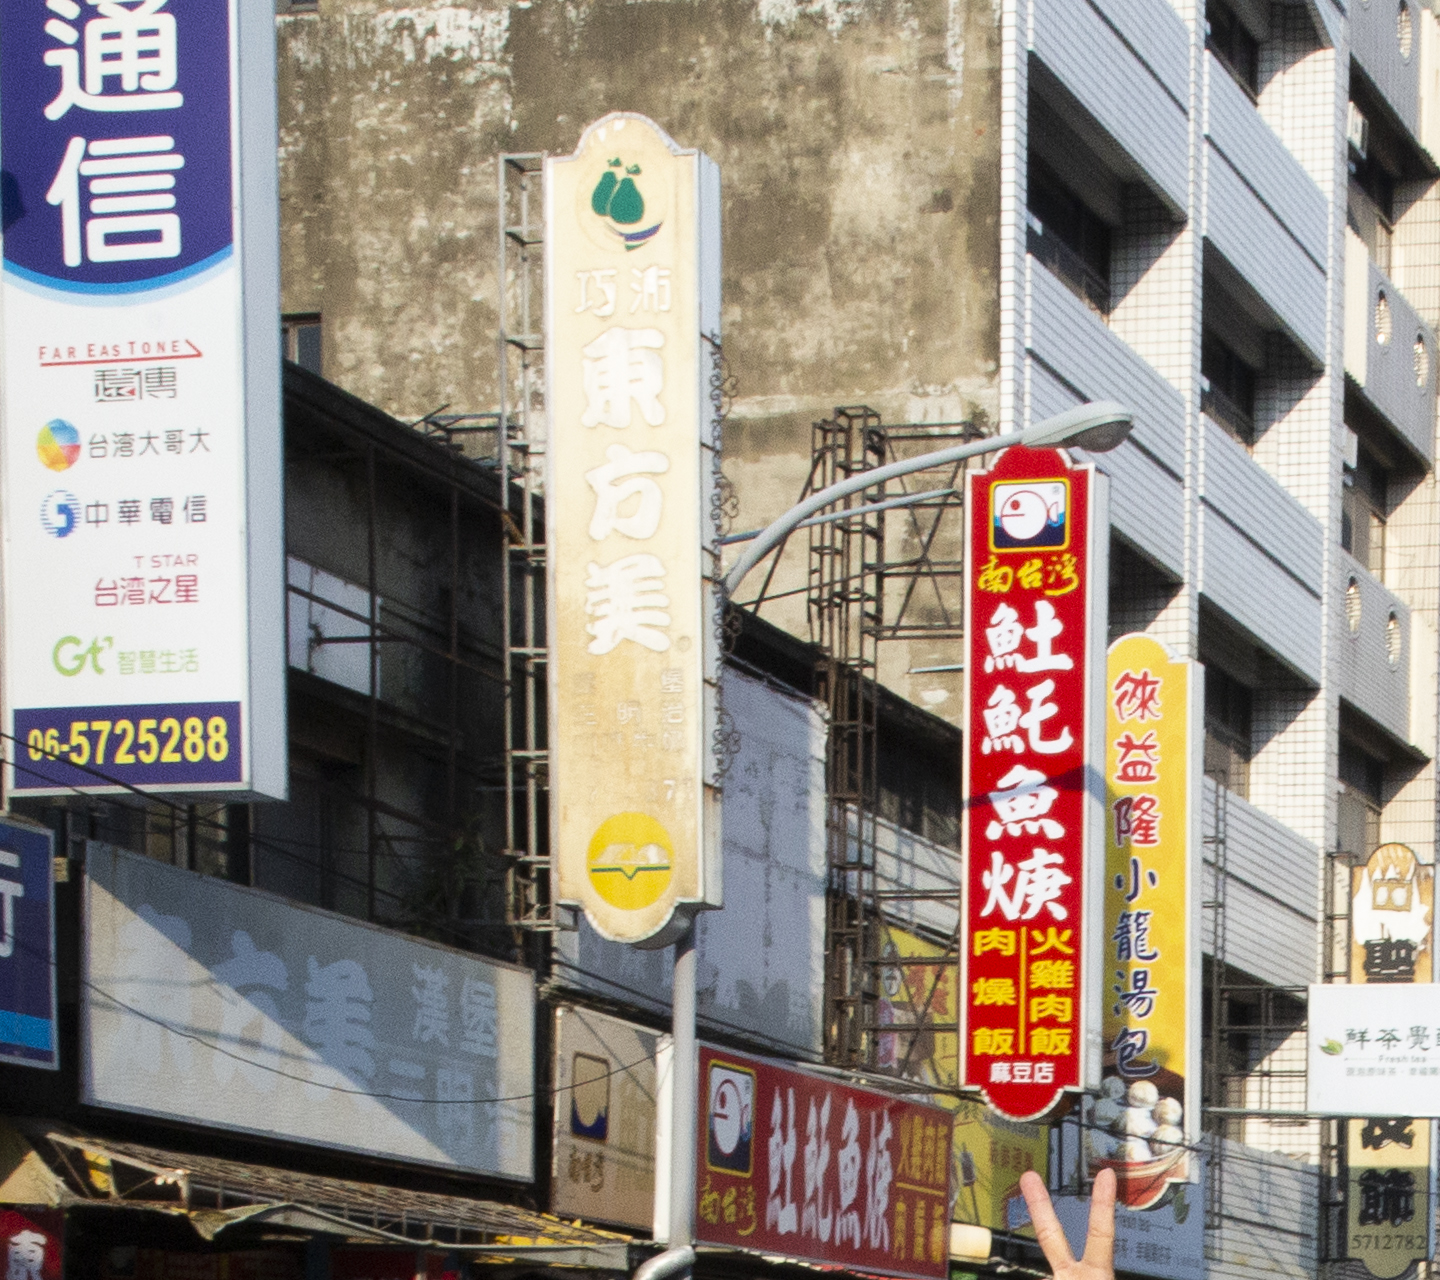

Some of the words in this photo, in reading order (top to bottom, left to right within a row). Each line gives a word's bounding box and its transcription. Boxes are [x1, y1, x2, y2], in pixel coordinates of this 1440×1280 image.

[88, 428, 210, 458] 台灣大哥大
[86, 495, 208, 527] 中華電信
[582, 326, 671, 657] 東方美
[151, 554, 199, 568] STAR
[117, 648, 199, 675] 智慧生活
[27, 716, 229, 766] 06-5725288
[972, 927, 1016, 1055] 肉燥飯
[1030, 927, 1074, 1055] 火雞肉飯
